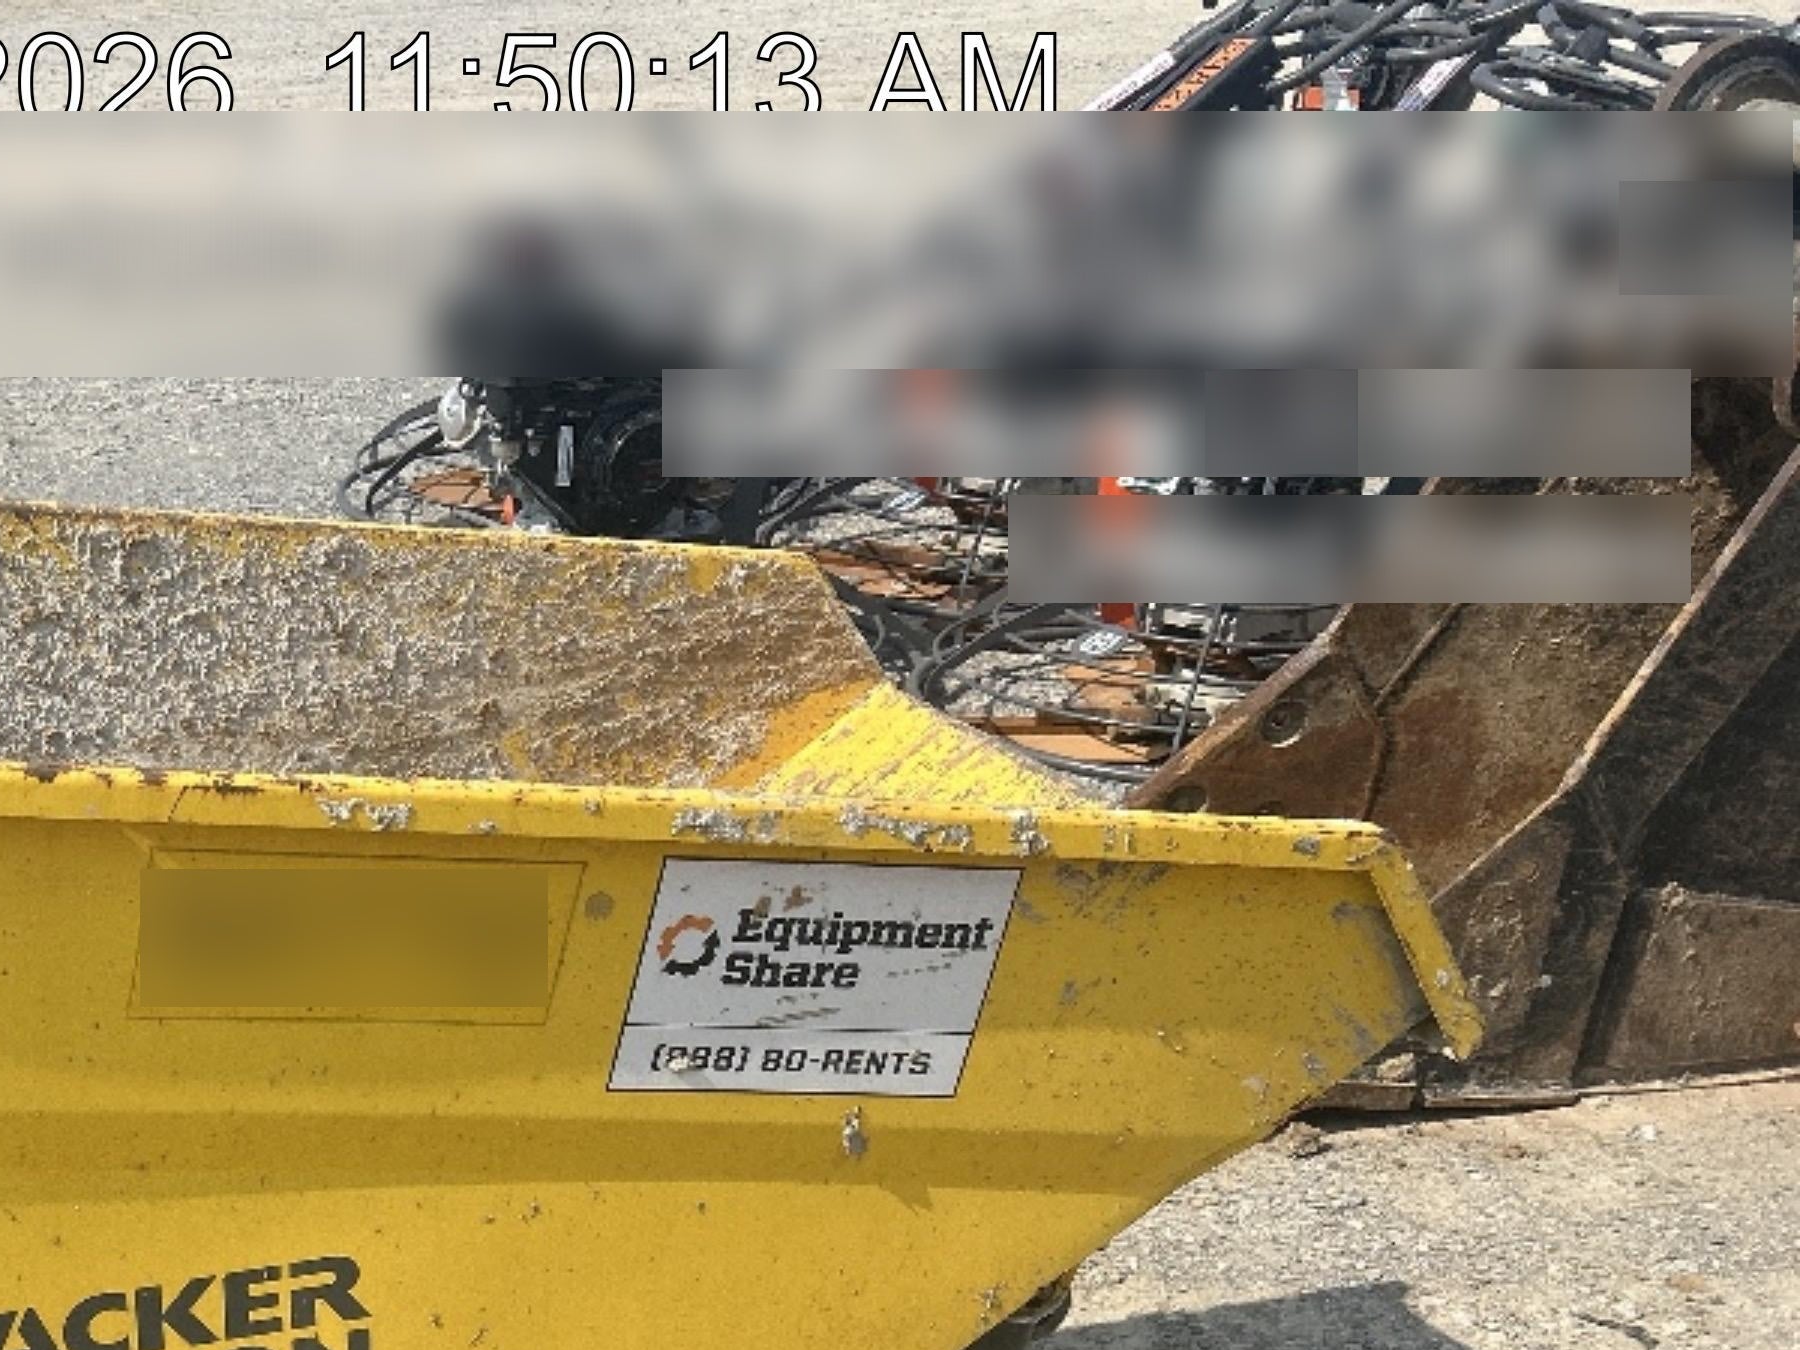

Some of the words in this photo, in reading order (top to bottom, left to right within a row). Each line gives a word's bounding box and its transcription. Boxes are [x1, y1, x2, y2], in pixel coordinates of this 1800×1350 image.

[731, 908, 994, 953] Equipment
[721, 952, 861, 989] Share
[761, 1049, 932, 1076] 80-RENTS
